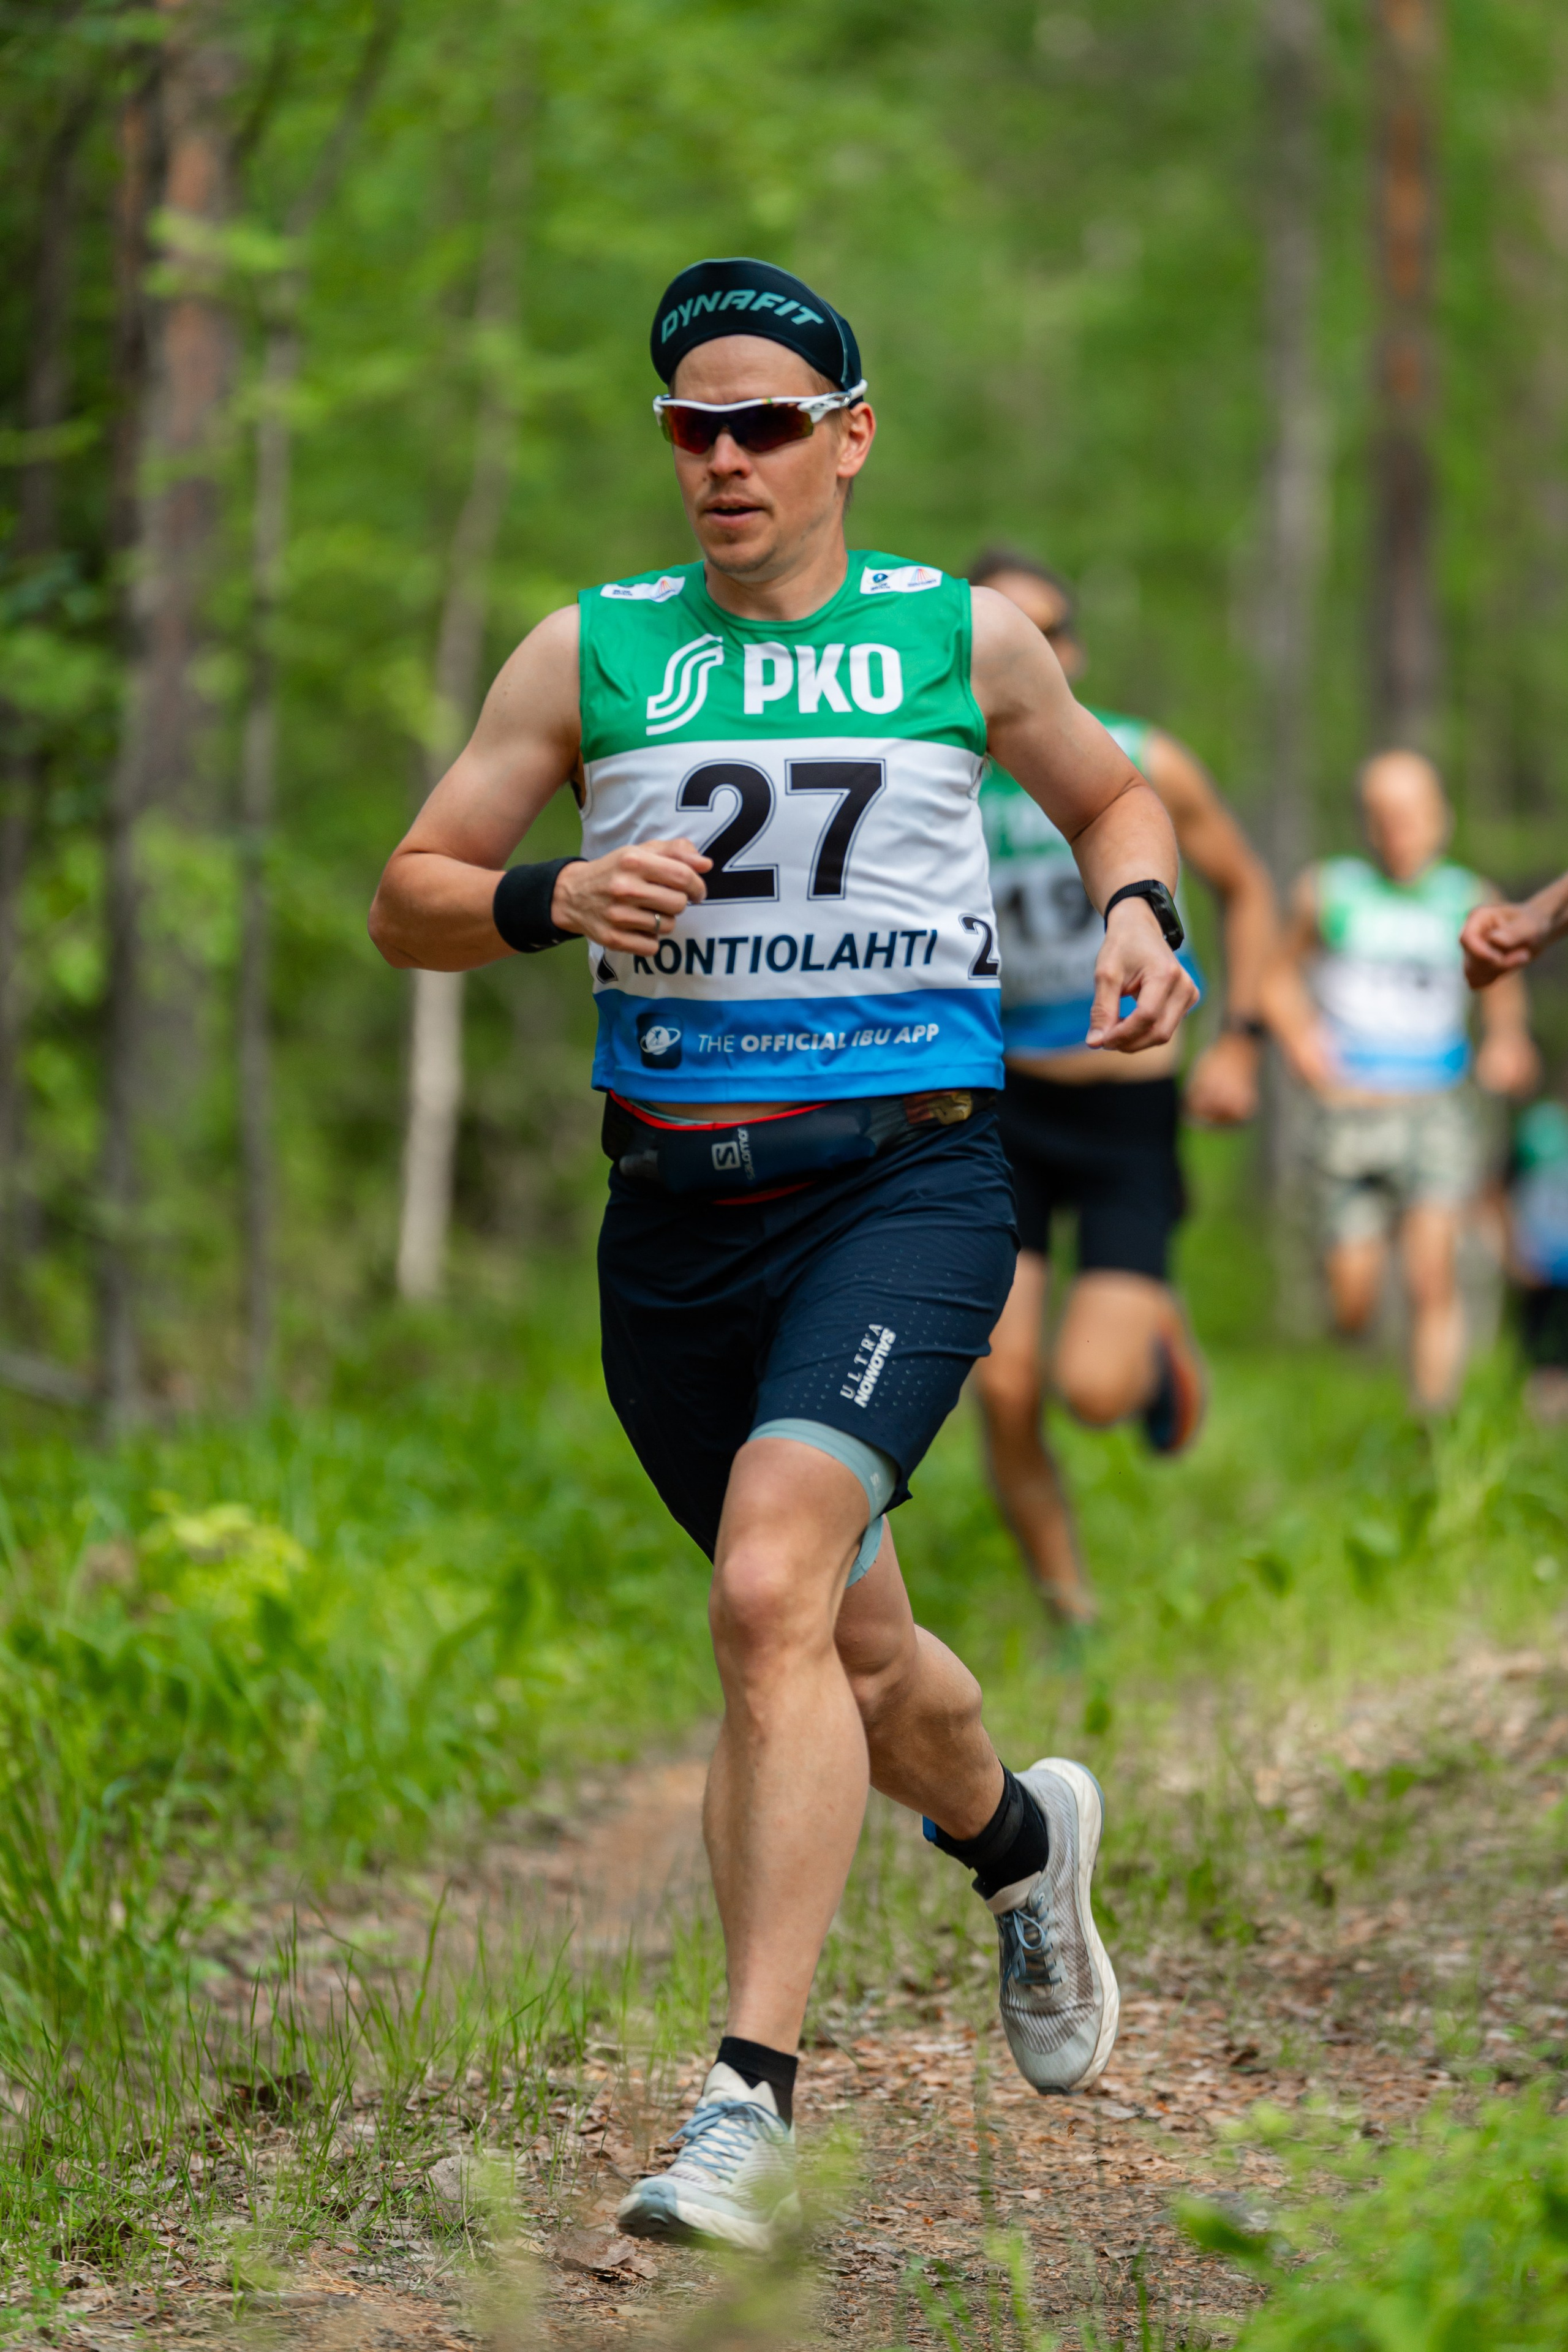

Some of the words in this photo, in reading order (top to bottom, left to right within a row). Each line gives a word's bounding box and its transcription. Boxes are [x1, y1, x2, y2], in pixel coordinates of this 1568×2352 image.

[661, 289, 824, 344] DYNAFIT
[743, 641, 904, 715] PKO
[676, 757, 887, 907] 27
[698, 1034, 735, 1053] THE
[741, 1031, 846, 1052] OFFICIAL
[851, 1028, 892, 1047] IBU
[894, 1023, 940, 1044] APP
[840, 1324, 883, 1400] ULTRA
[854, 1327, 897, 1409] SALOMON
